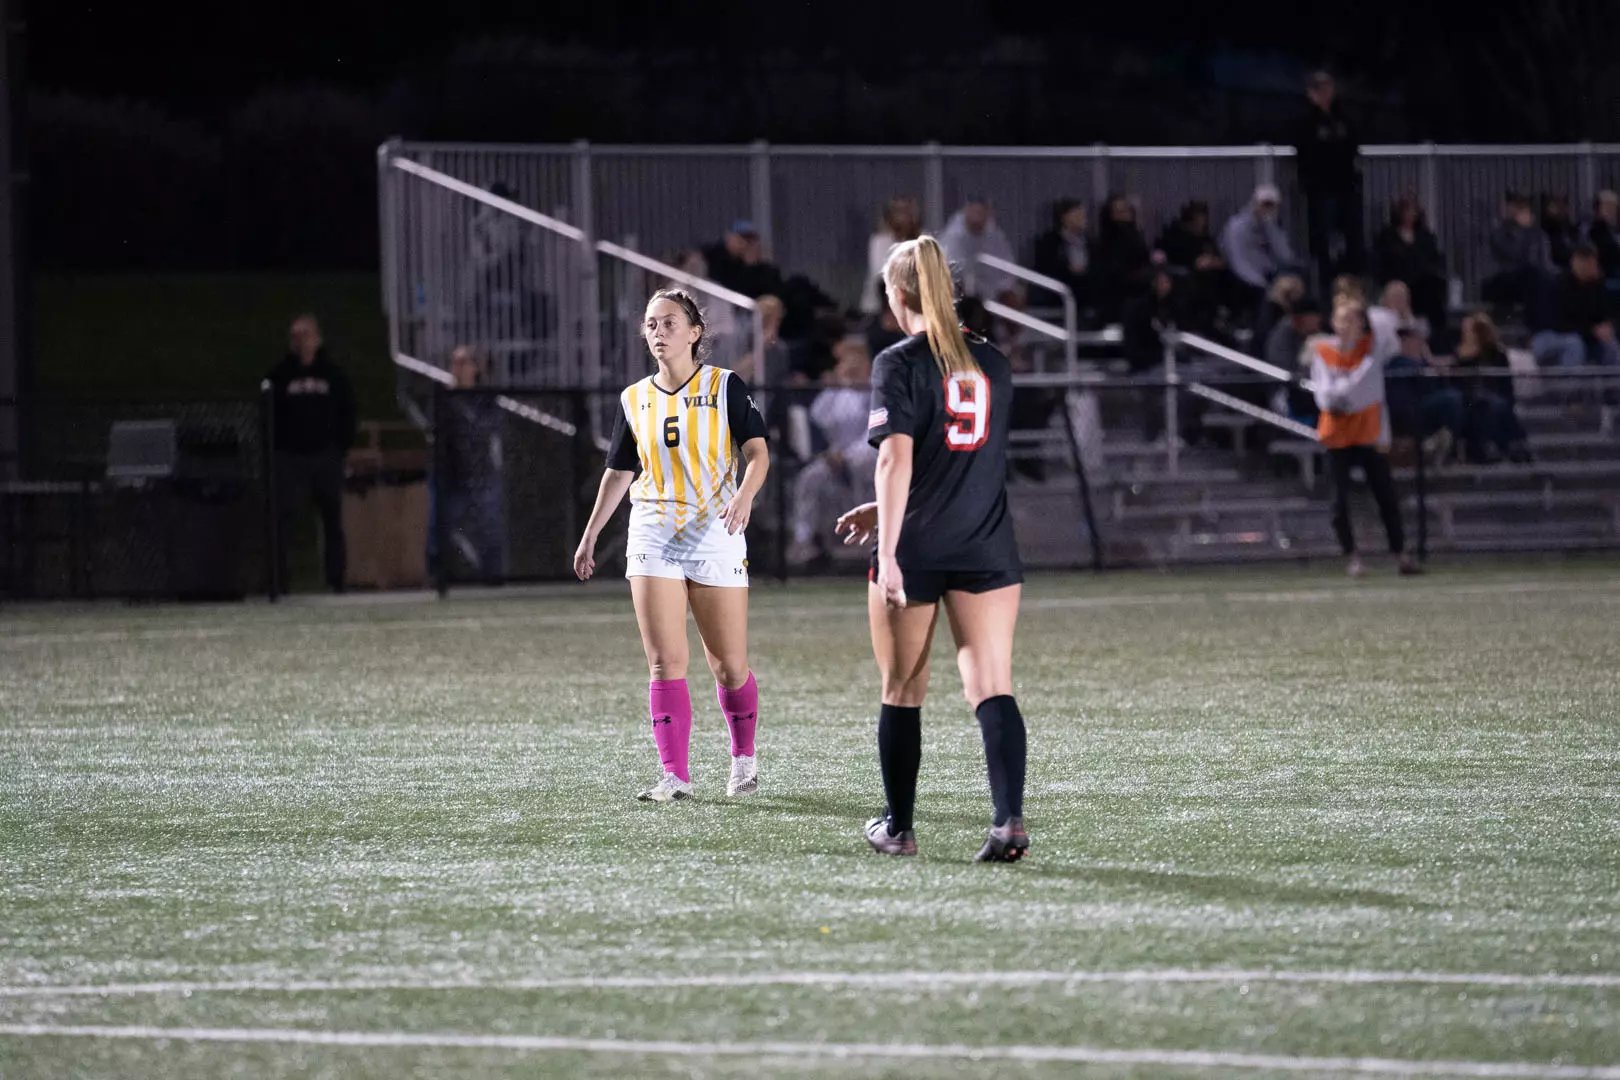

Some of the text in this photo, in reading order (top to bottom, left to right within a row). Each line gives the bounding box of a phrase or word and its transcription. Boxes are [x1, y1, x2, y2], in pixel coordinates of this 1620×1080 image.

[683, 394, 718, 410] VILLE
[944, 370, 990, 452] 9
[663, 415, 680, 448] 6
